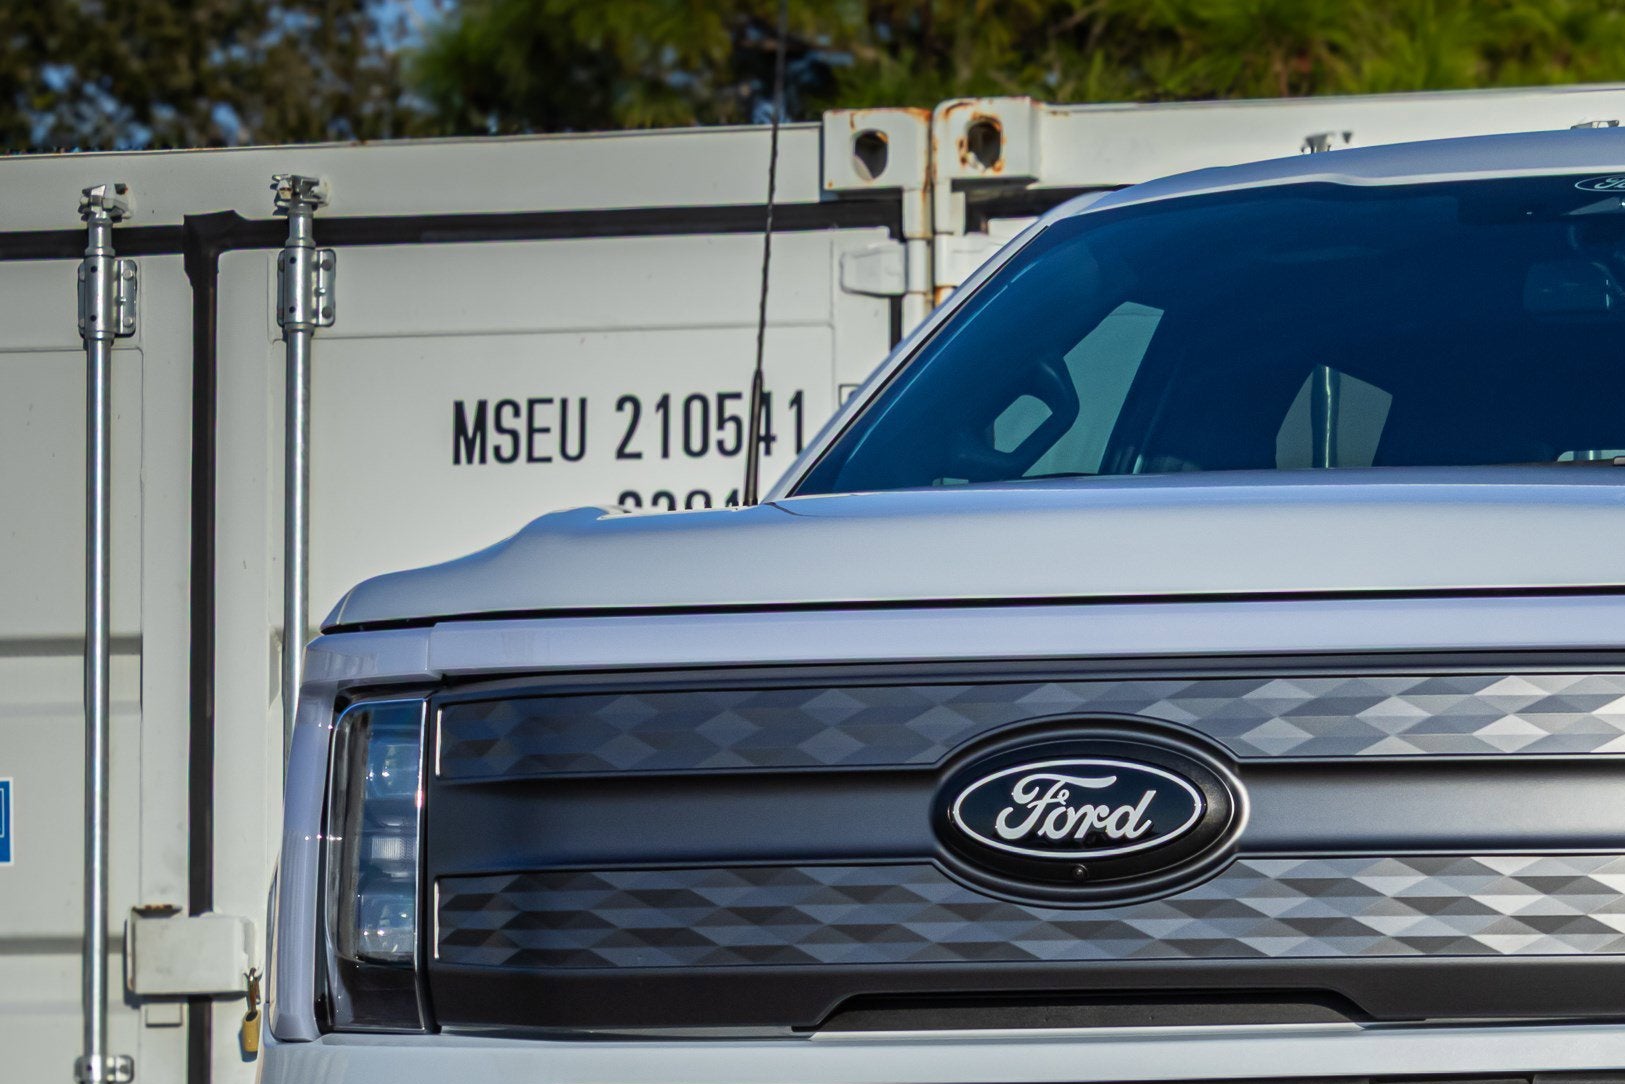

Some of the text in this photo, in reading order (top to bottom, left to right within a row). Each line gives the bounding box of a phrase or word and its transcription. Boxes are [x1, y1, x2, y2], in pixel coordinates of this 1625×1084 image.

[453, 390, 804, 465] MSEU 210541
[995, 773, 1157, 840] Ford
